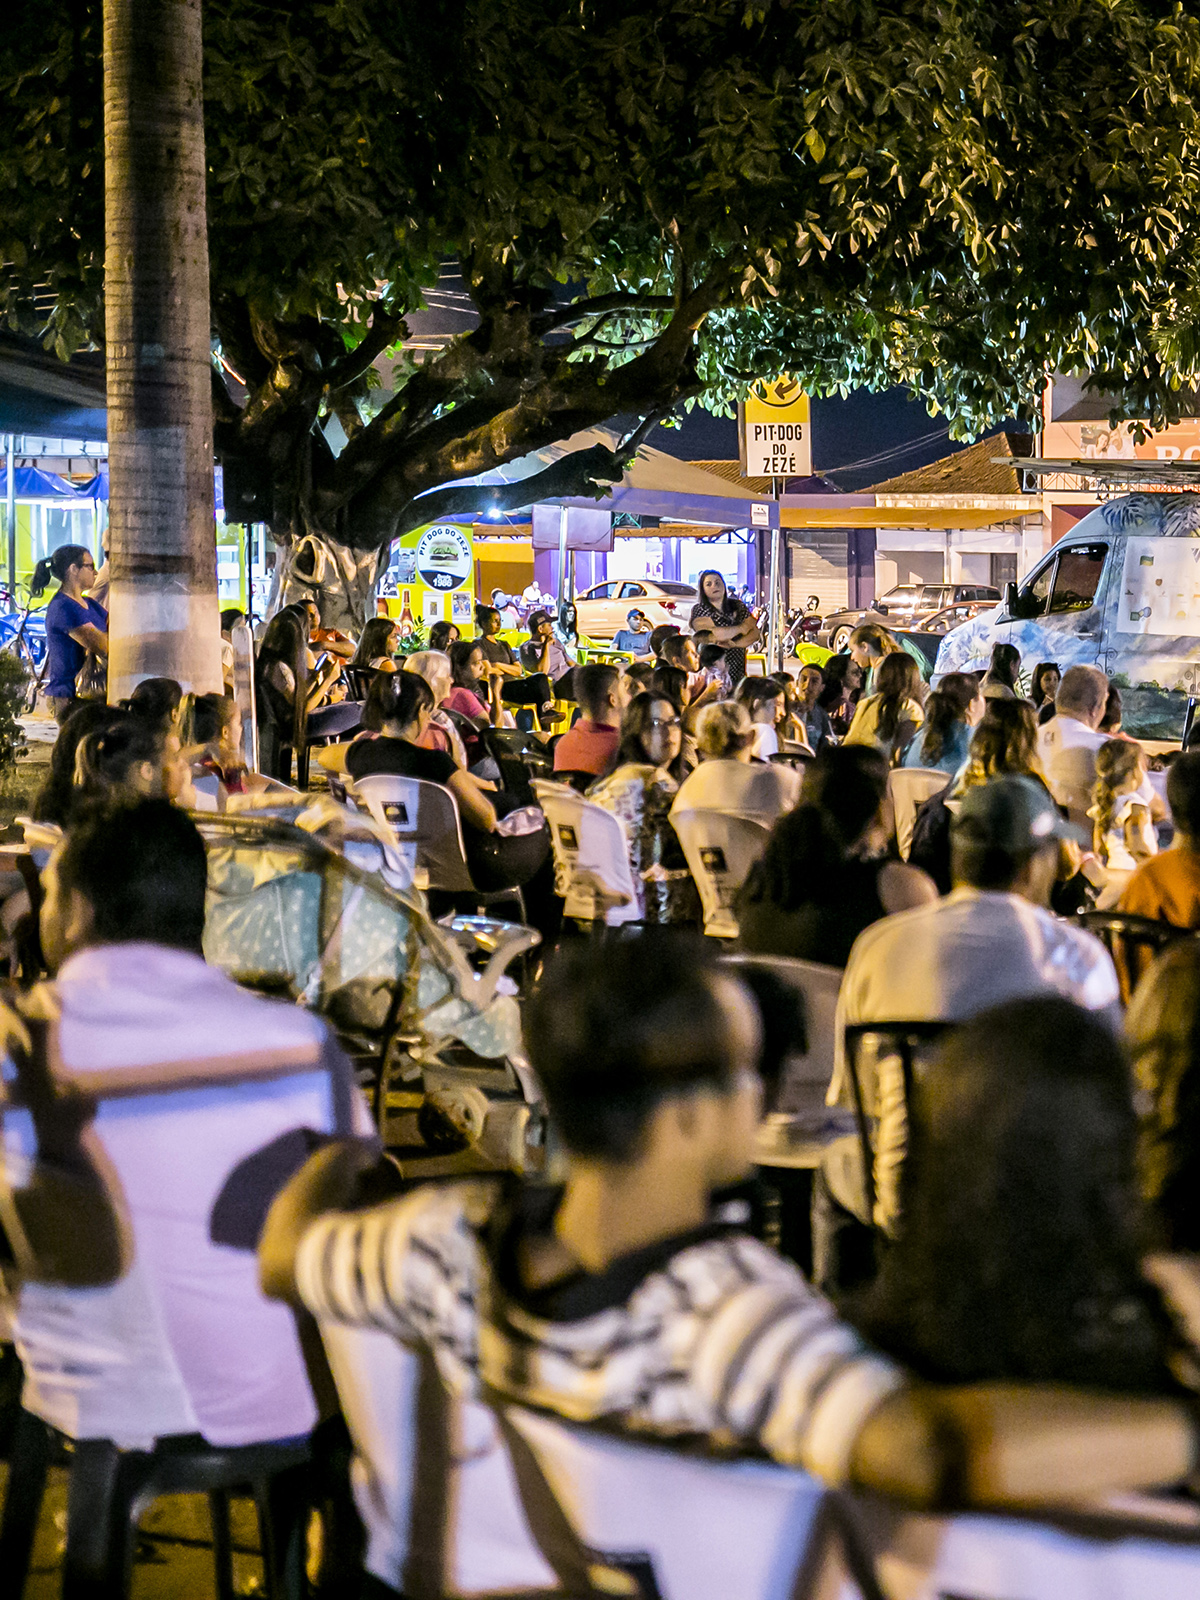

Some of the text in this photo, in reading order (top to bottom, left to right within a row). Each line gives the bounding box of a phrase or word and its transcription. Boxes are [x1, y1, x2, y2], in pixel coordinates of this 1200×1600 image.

[772, 444, 787, 456] DO
[763, 452, 796, 473] ZEZÉ
[419, 540, 428, 556] PIT
[427, 528, 443, 541] DOG
[445, 528, 456, 537] DO
